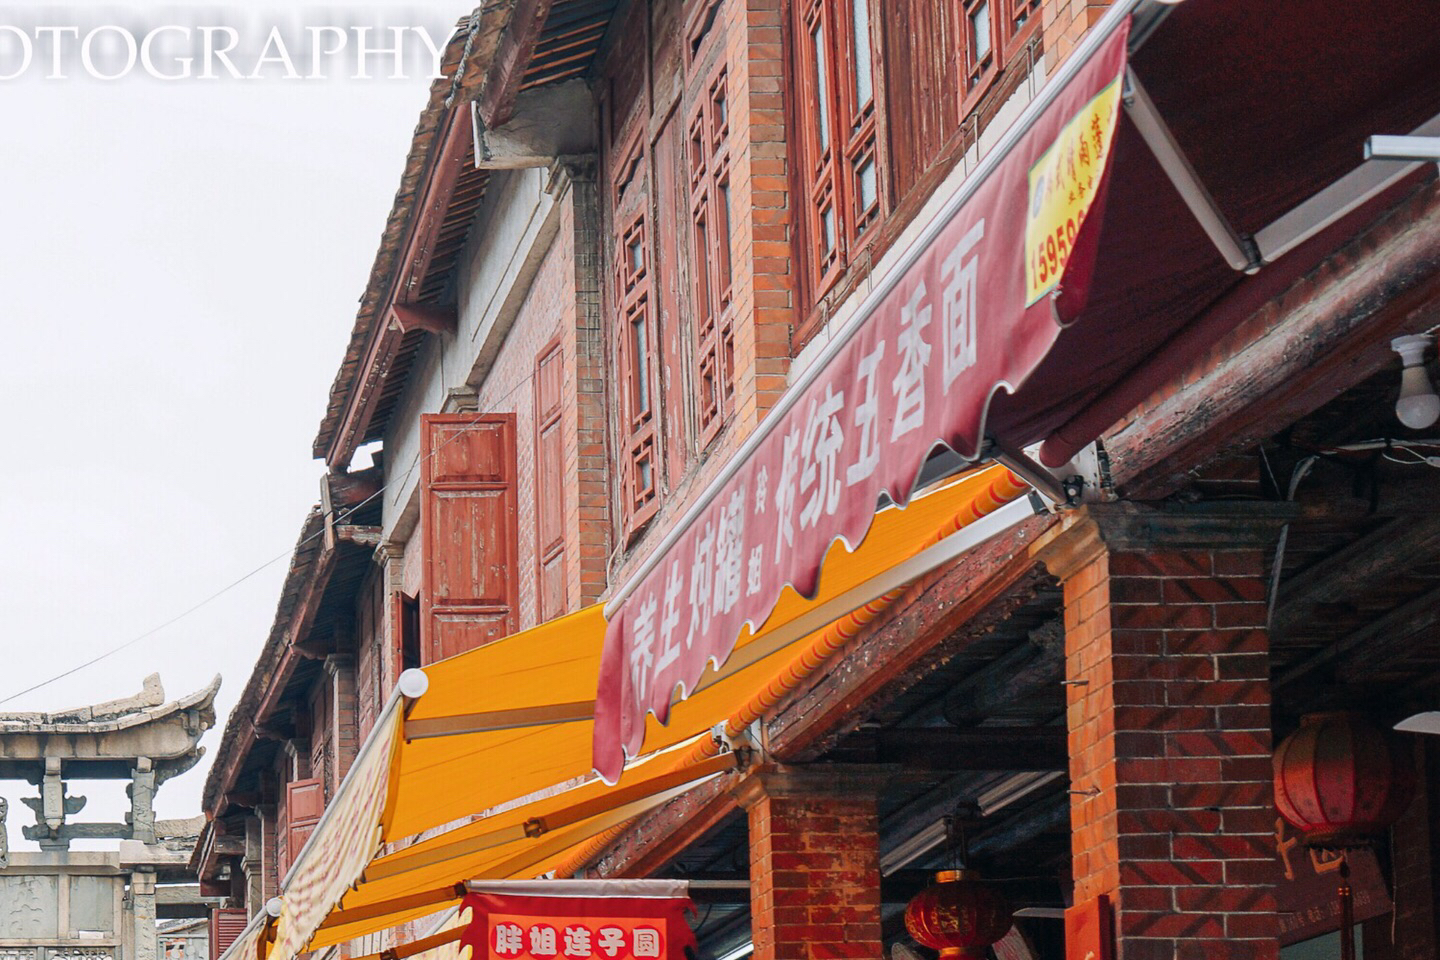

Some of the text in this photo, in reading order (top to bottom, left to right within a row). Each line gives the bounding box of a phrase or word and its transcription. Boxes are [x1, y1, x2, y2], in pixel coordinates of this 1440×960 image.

[774, 217, 986, 565] 传统五香面
